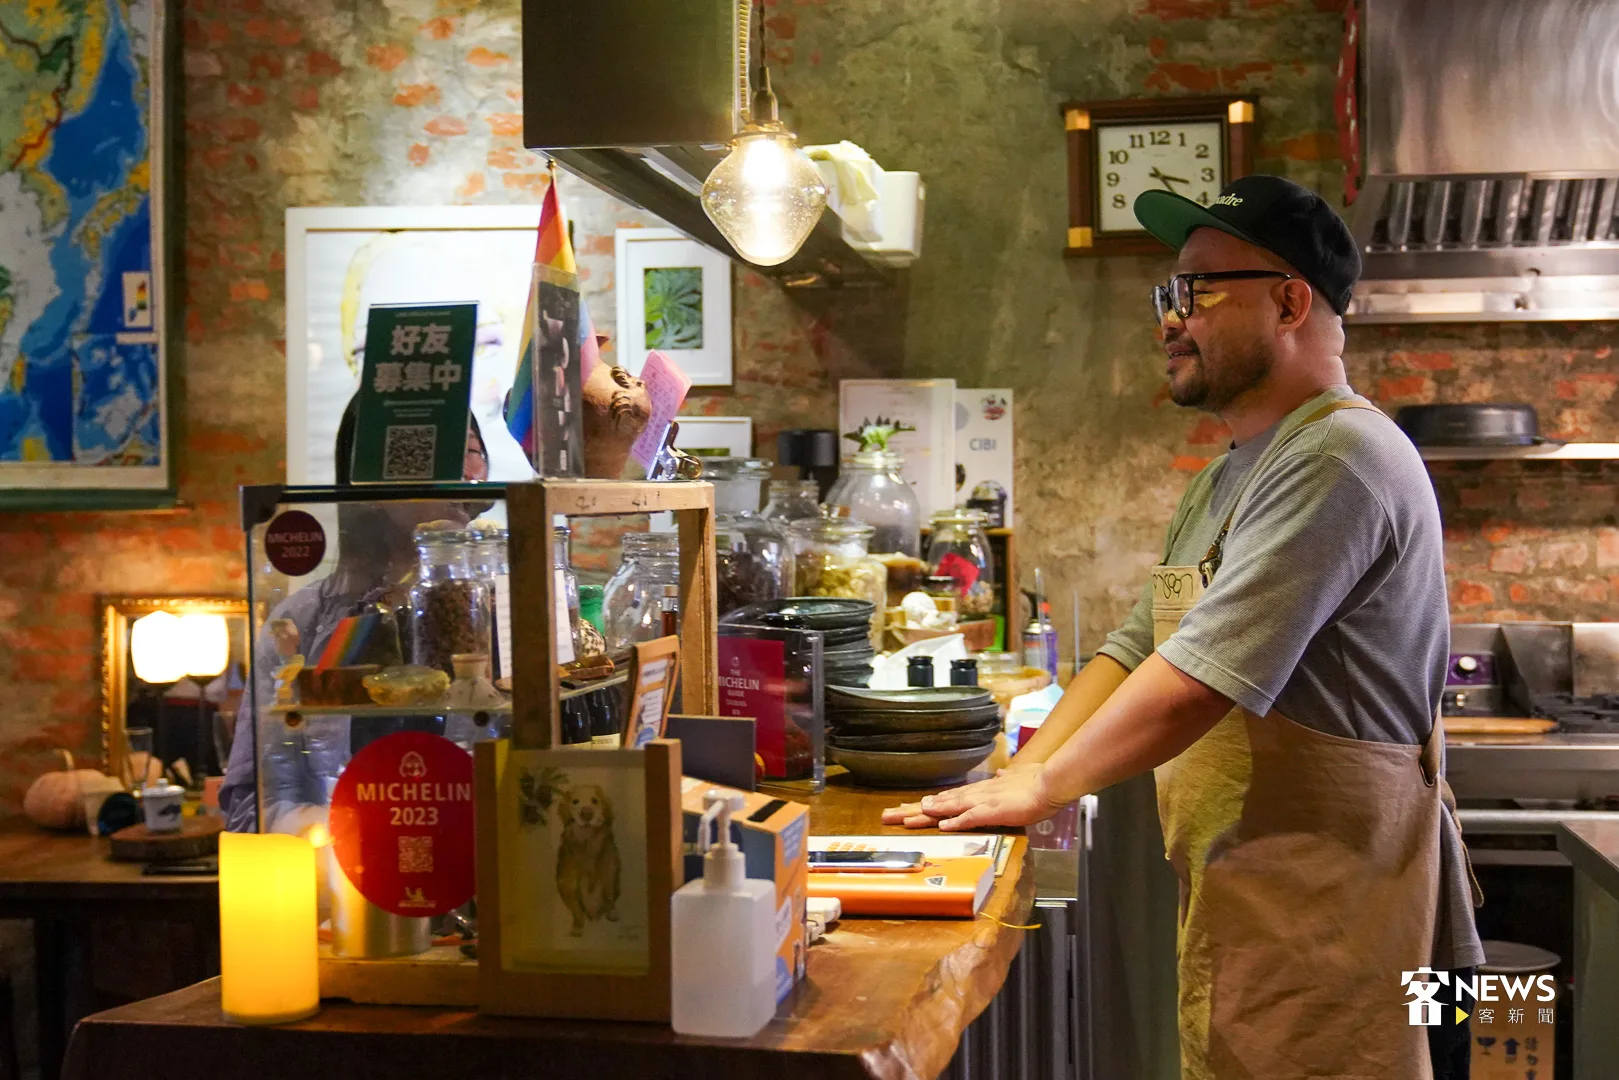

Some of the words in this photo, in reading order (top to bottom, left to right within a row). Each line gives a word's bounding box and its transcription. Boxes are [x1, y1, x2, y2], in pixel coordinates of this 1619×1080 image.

[1129, 134, 1145, 148] 11
[1149, 131, 1170, 145] 12
[1178, 132, 1186, 147] 1
[1108, 150, 1129, 164] 10
[1195, 144, 1209, 158] 2
[1106, 172, 1120, 187] 9
[1201, 167, 1215, 182] 3
[1112, 194, 1126, 209] 8
[1196, 191, 1208, 205] 4
[391, 323, 452, 356] 好友
[373, 360, 462, 393] 募集中
[969, 438, 997, 451] CIBI
[267, 531, 323, 543] MICHELIN
[356, 783, 471, 801] MICHELIN
[389, 807, 439, 825] 2023
